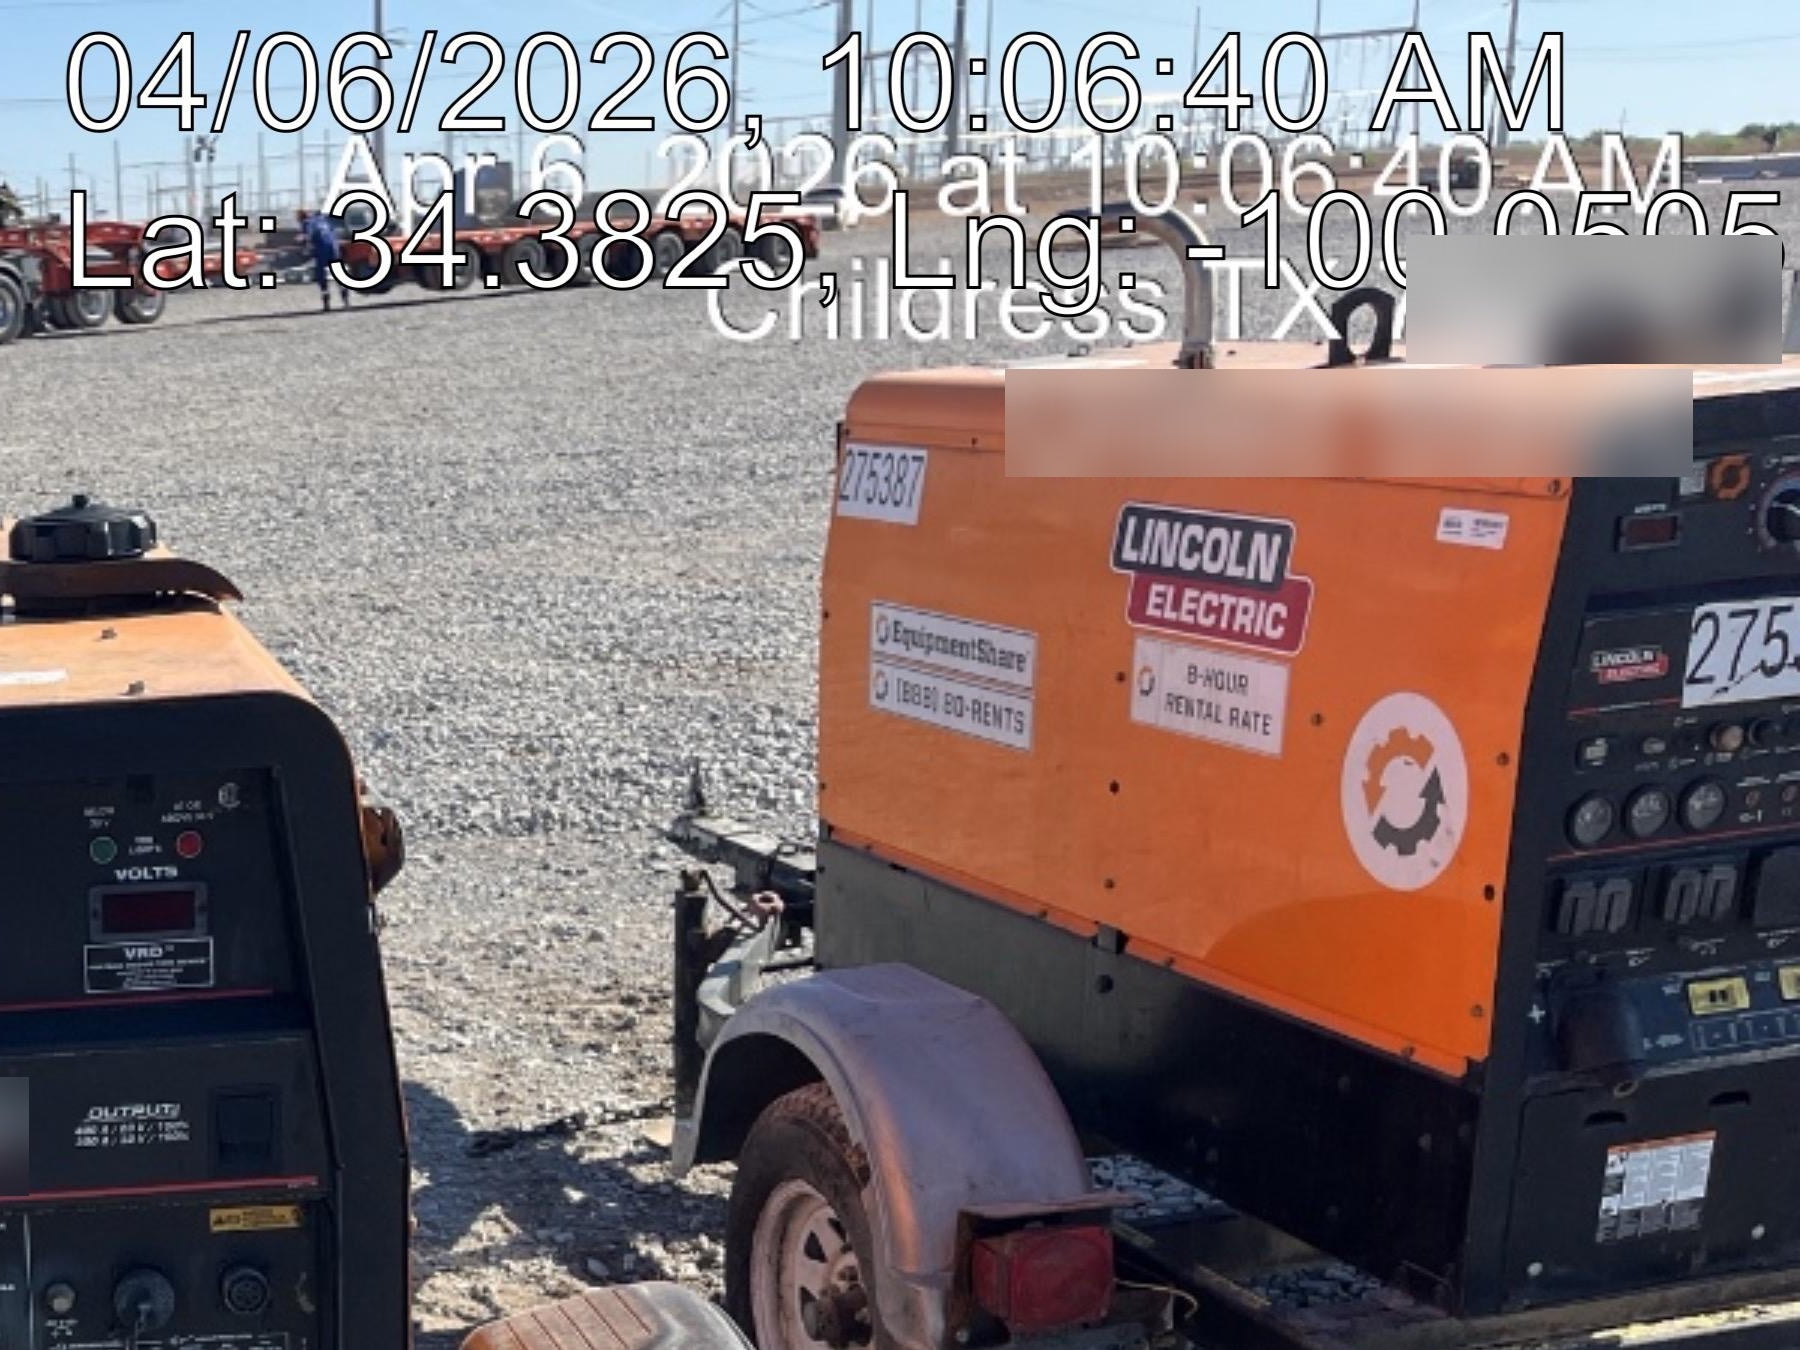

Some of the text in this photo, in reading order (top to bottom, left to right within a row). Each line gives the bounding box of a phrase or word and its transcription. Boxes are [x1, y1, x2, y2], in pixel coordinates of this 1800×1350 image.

[840, 449, 925, 508] 275387
[1121, 516, 1282, 583] LINCOLN
[1145, 584, 1288, 640] ELECTRIC
[893, 619, 1027, 673] EquipmentShare
[1684, 603, 1800, 688] 275
[1164, 692, 1271, 736] RENTAL RATE
[115, 865, 178, 882] VOLTS
